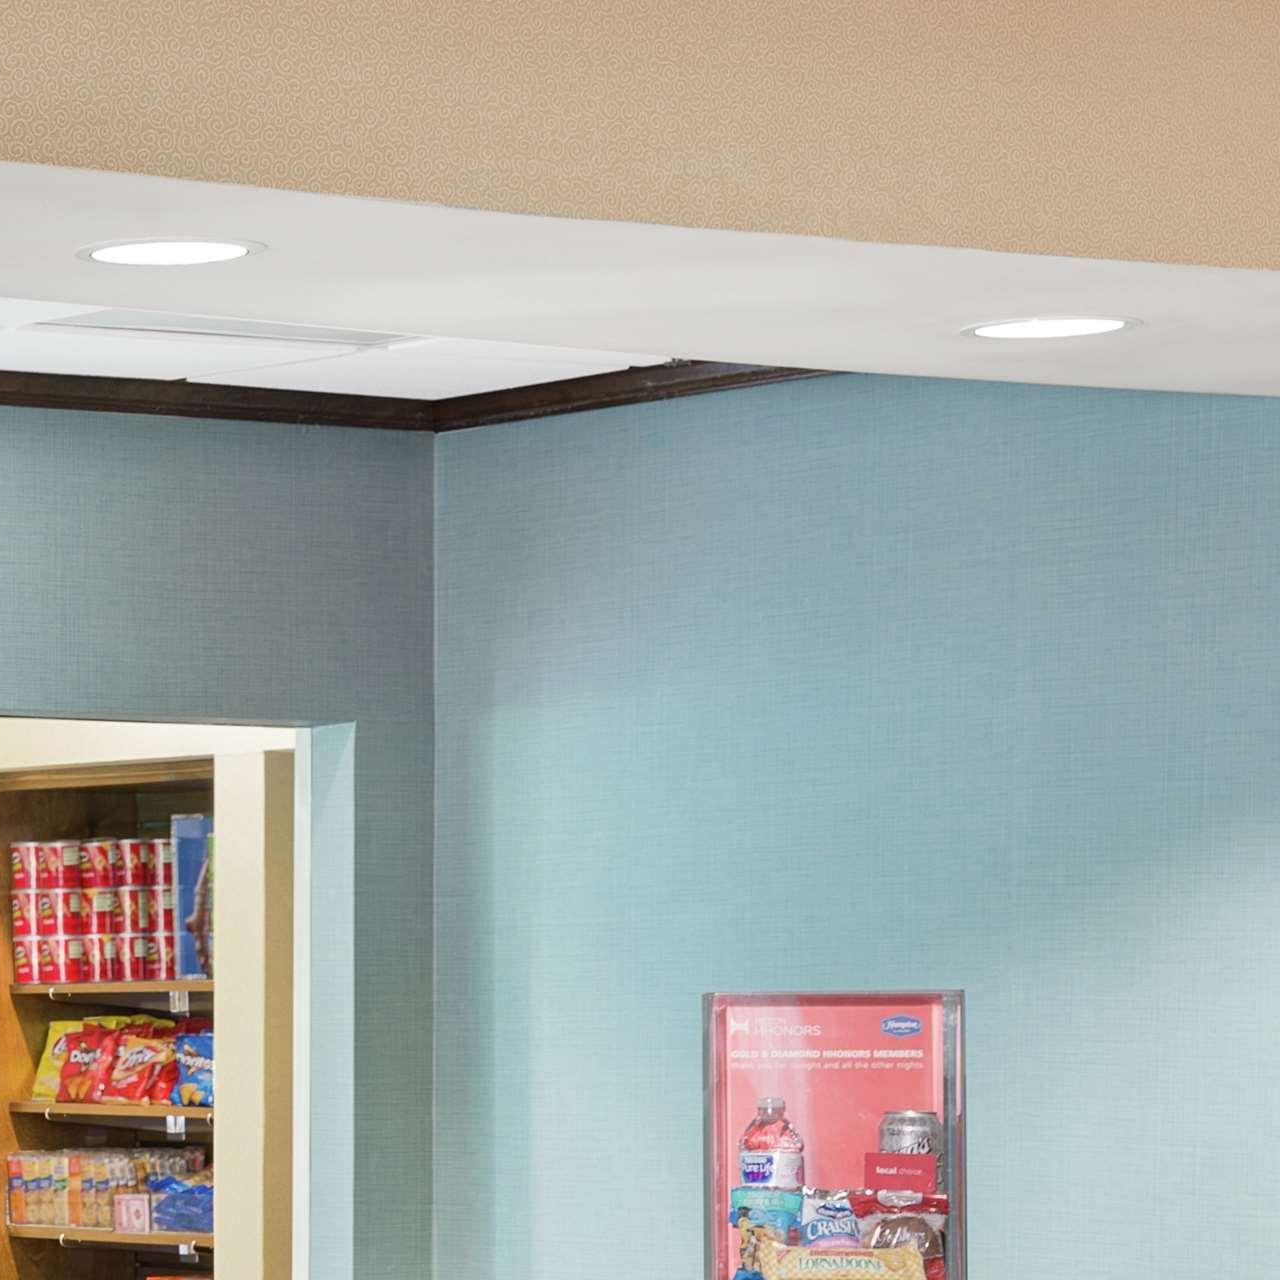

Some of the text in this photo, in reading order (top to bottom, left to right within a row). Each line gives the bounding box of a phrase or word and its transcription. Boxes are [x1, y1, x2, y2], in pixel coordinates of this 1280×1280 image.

[731, 1049, 759, 1058] GOLD
[770, 1049, 821, 1058] DIAMOND
[822, 1049, 871, 1058] HHONORS
[873, 1049, 924, 1058] MEMBERS
[823, 1062, 840, 1070] and
[855, 1062, 869, 1070] the
[870, 1062, 894, 1070] other
[875, 1166, 898, 1175] local
